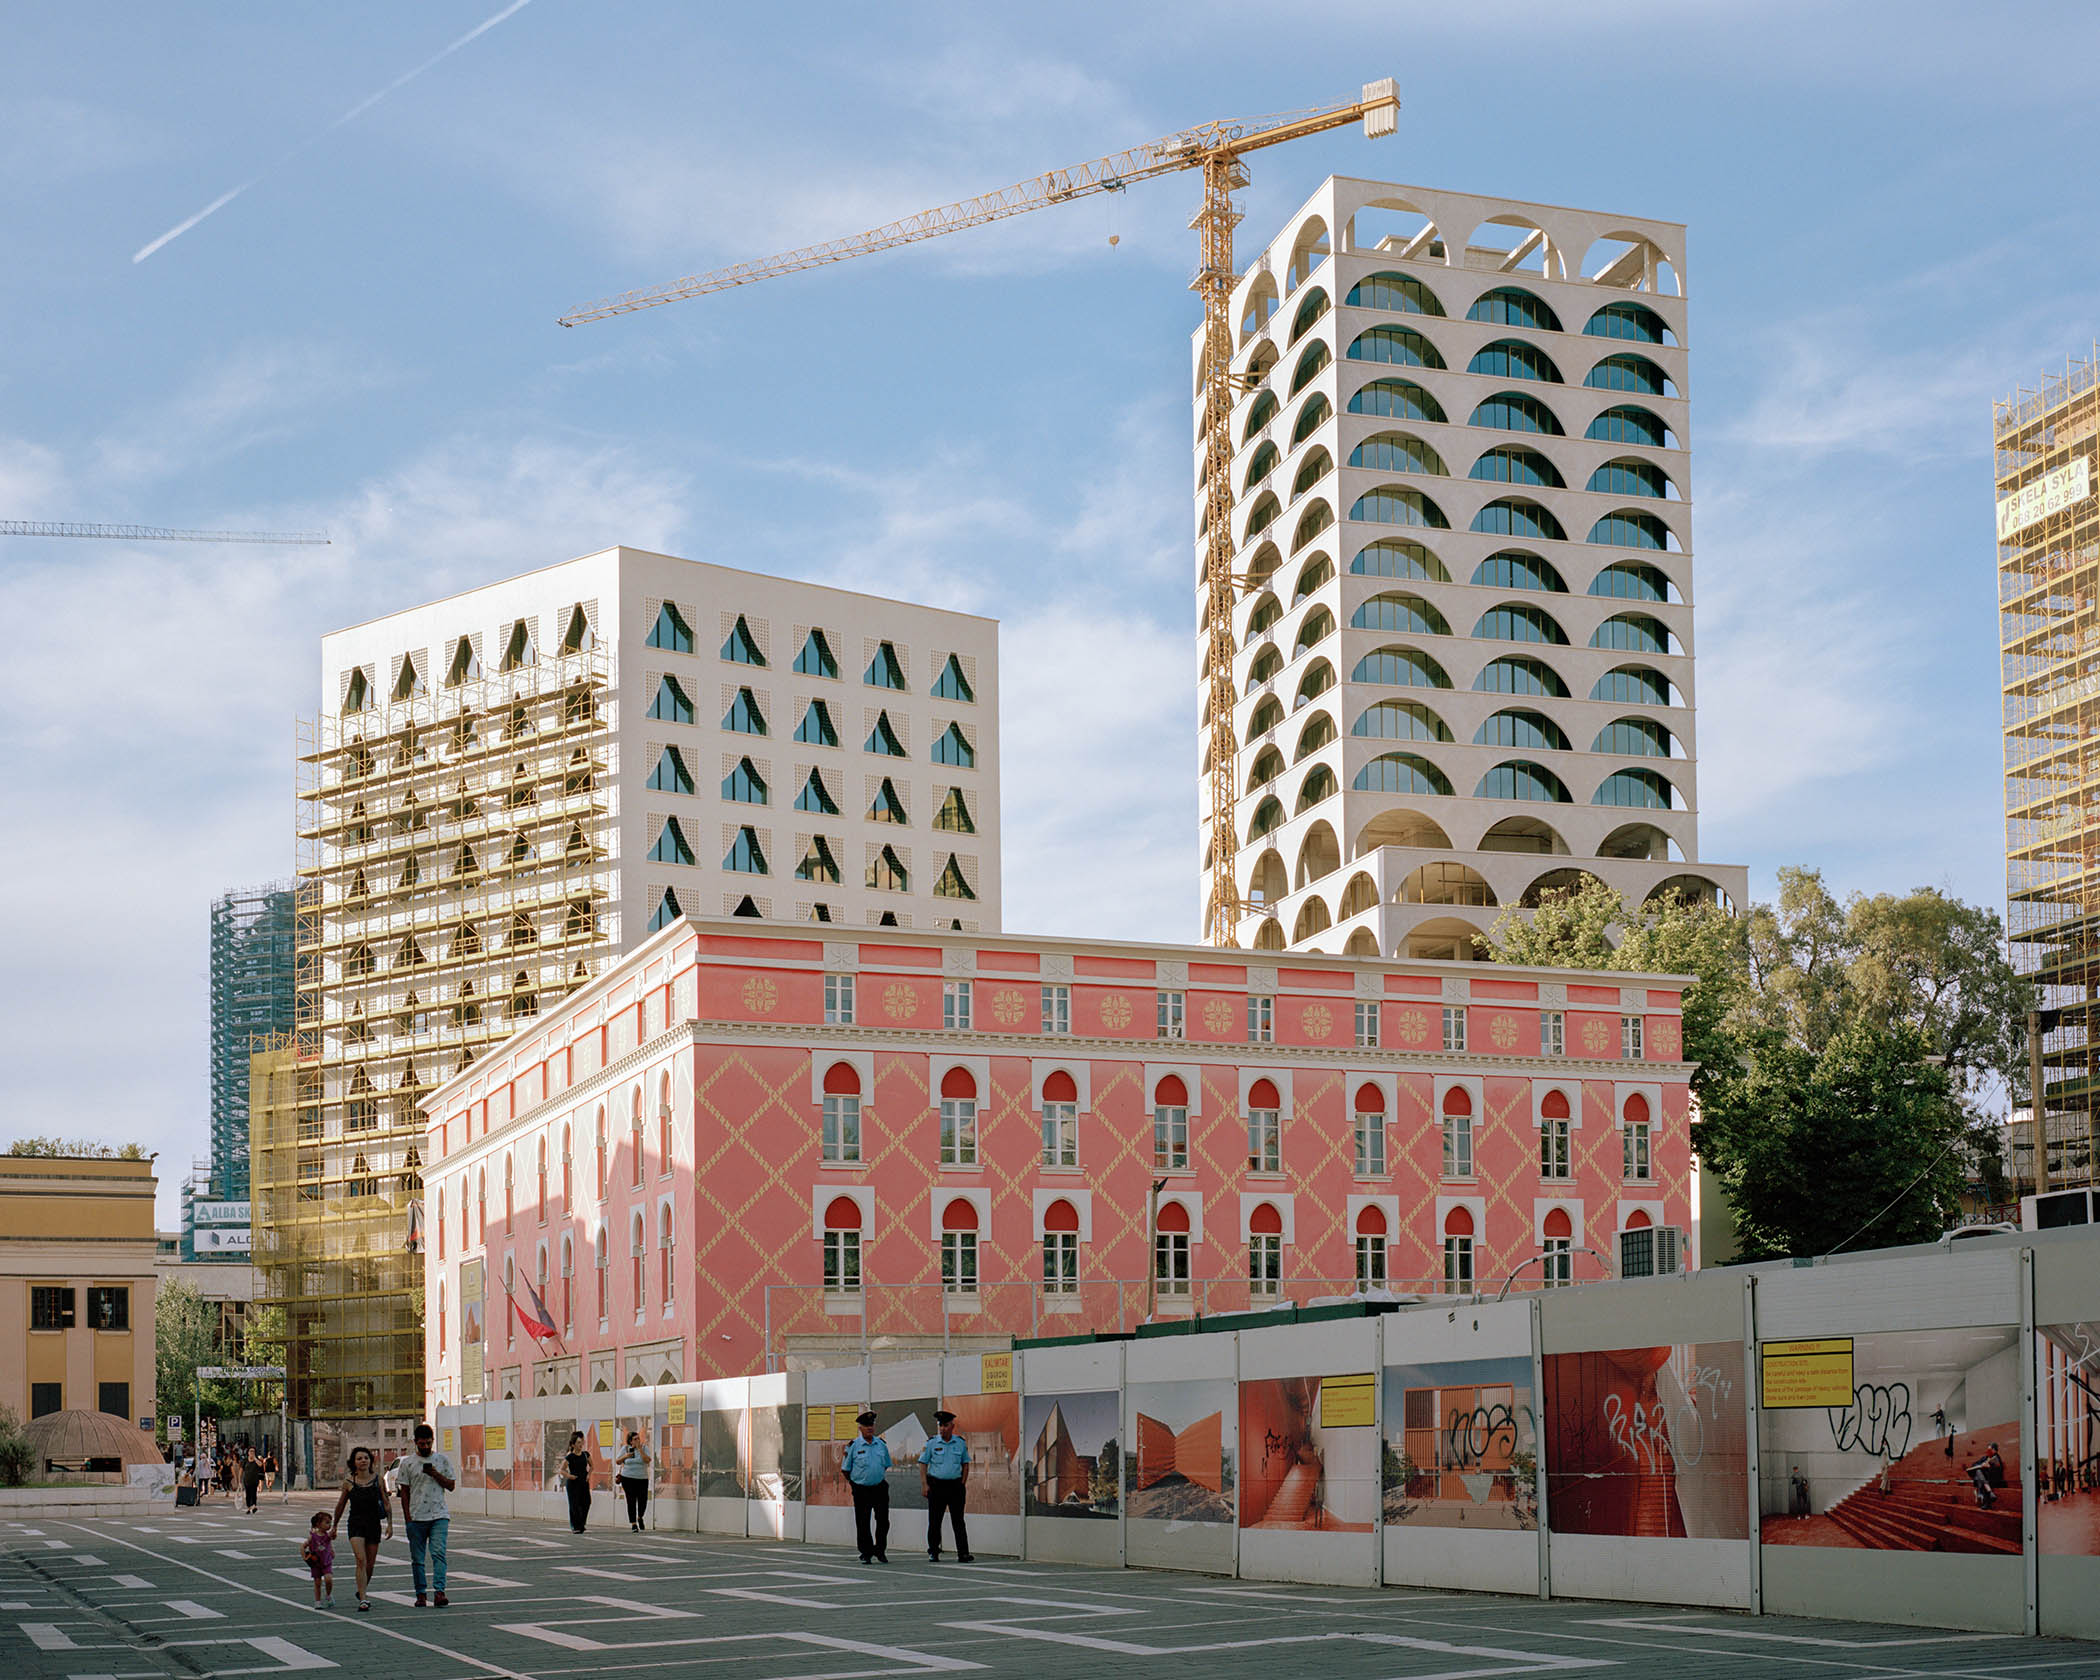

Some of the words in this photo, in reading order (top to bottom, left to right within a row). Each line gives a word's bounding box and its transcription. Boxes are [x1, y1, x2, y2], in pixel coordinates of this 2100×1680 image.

[2010, 480, 2047, 512] SKELA
[2051, 462, 2084, 490] SYLA
[2012, 510, 2030, 529] 068
[2032, 502, 2045, 518] 20
[2046, 494, 2061, 510] 62
[2062, 483, 2083, 503] 999
[211, 1206, 237, 1219] ALBA
[1788, 1343, 1815, 1352] WARNING
[171, 1417, 179, 1427] P
